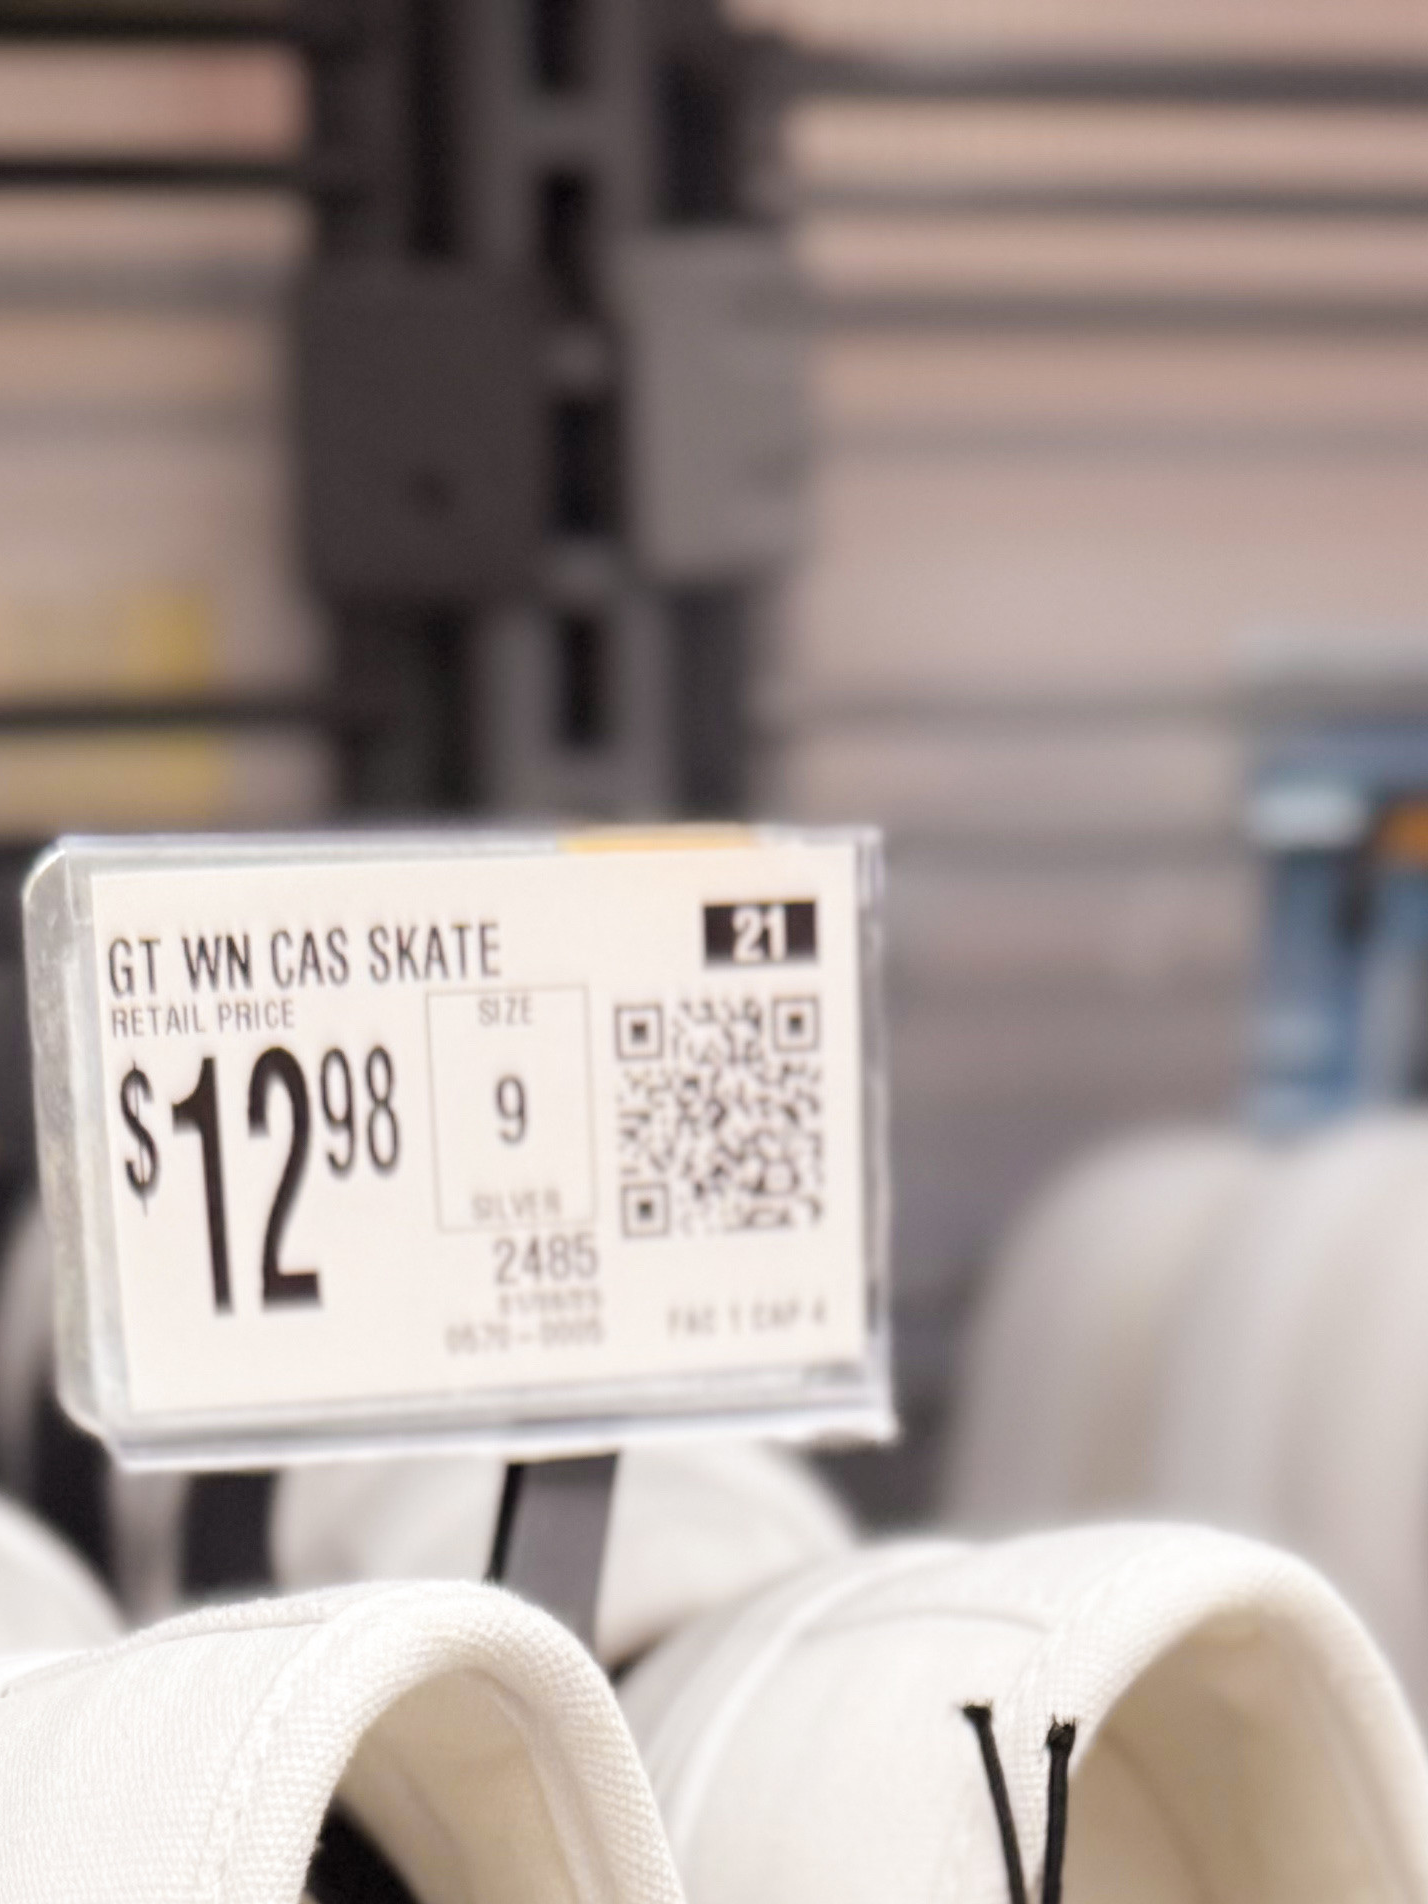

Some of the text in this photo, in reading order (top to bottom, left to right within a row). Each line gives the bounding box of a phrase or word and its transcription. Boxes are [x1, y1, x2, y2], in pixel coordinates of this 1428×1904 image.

[108, 923, 501, 997] GT WN CAS SKATE
[732, 904, 786, 962] 21
[112, 1000, 295, 1038] RETAIL PRICE
[478, 997, 532, 1026] SIZE
[496, 1075, 526, 1143] 9
[493, 1232, 598, 1286] 2485
